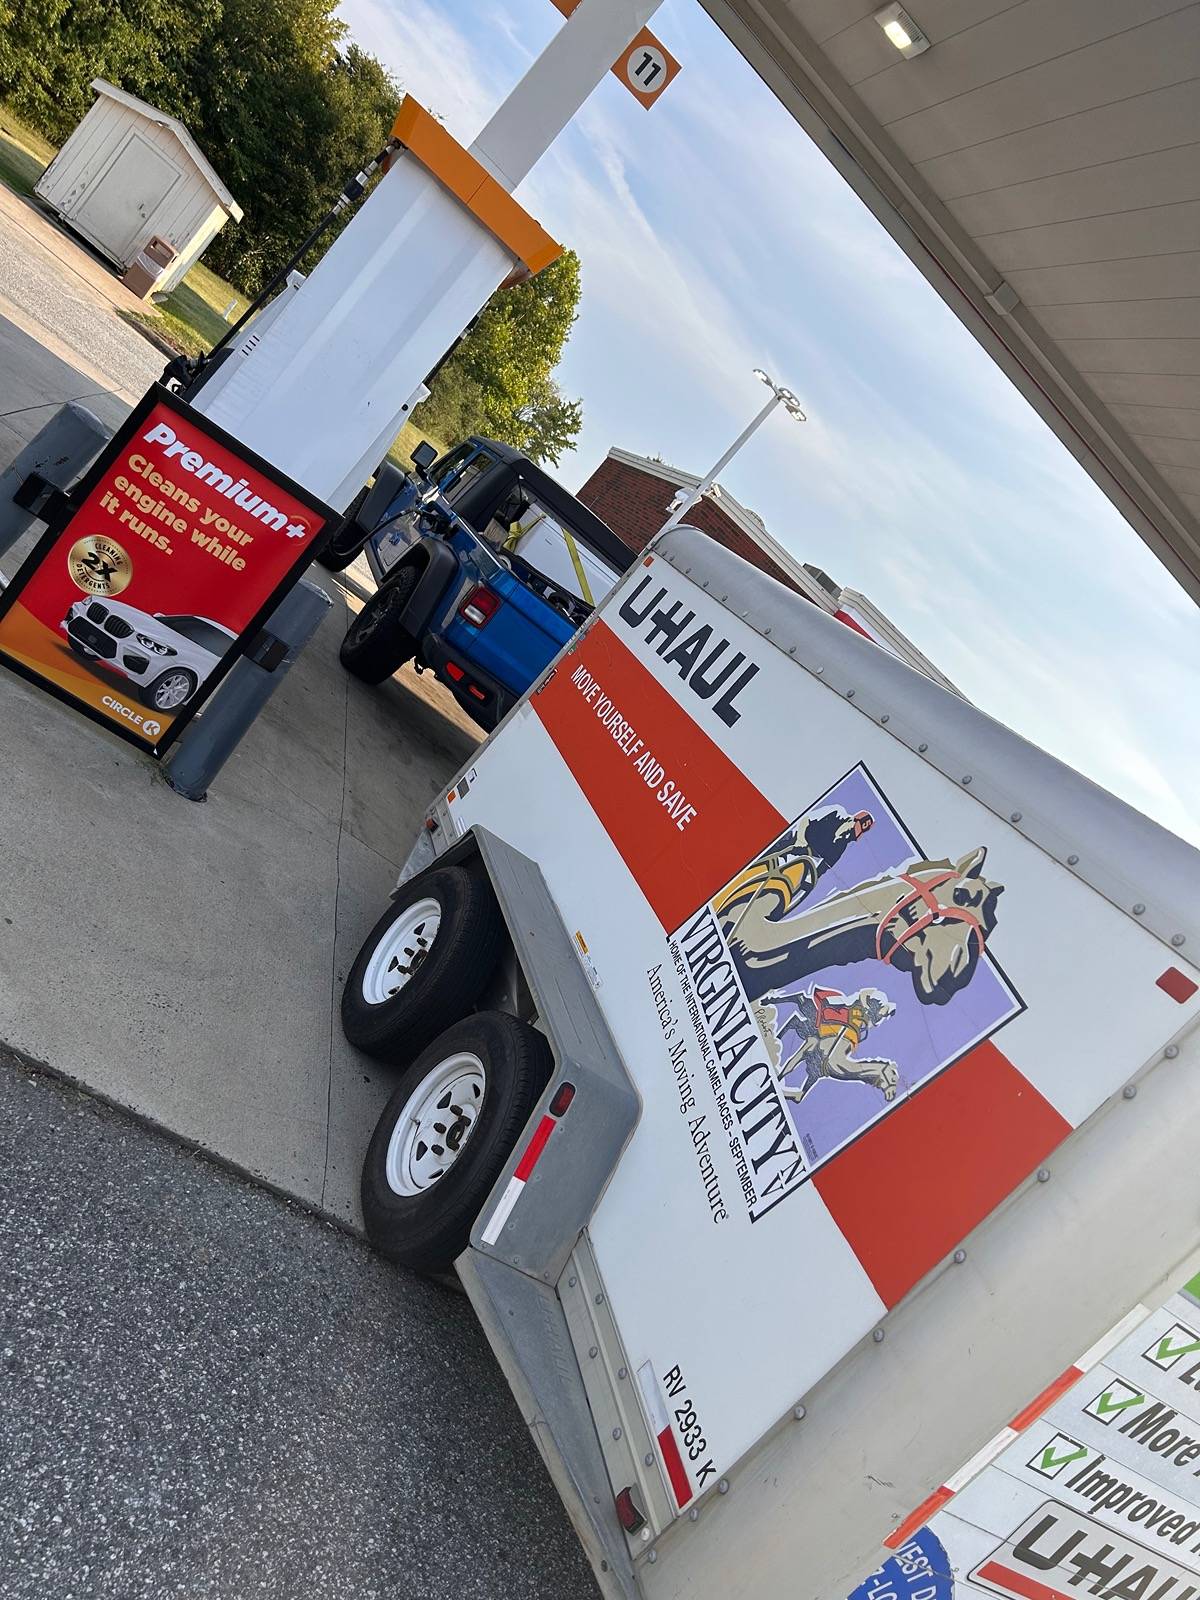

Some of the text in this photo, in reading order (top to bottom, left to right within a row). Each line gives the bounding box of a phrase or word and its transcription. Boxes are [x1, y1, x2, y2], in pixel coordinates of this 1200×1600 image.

[634, 51, 662, 87] 11
[128, 454, 254, 547] Cleans your
[143, 422, 306, 539] Premium+
[99, 491, 173, 556] it runs.
[114, 475, 246, 572] engine while
[76, 563, 111, 590] DETERGENTS
[618, 574, 761, 729] U-HAUL
[102, 695, 161, 736] CIRCLE K
[570, 664, 698, 832] MOVE YOURSELF AND SAVE
[668, 939, 683, 966] HOME
[676, 963, 687, 976] OF
[680, 974, 692, 995] THE
[646, 963, 679, 1040] America's
[668, 1037, 696, 1115] Moving
[680, 905, 759, 1080] VIRGINIA
[729, 1062, 799, 1176] CITY
[684, 991, 712, 1062] INTERNATIONAL
[705, 1058, 722, 1096] CAMEL
[715, 1092, 734, 1131] RACES
[729, 1136, 758, 1209] SEPTEMBER
[662, 1363, 717, 1489] RV 2933 K
[1117, 1401, 1200, 1468] More
[1012, 1513, 1199, 1600] U-HA
